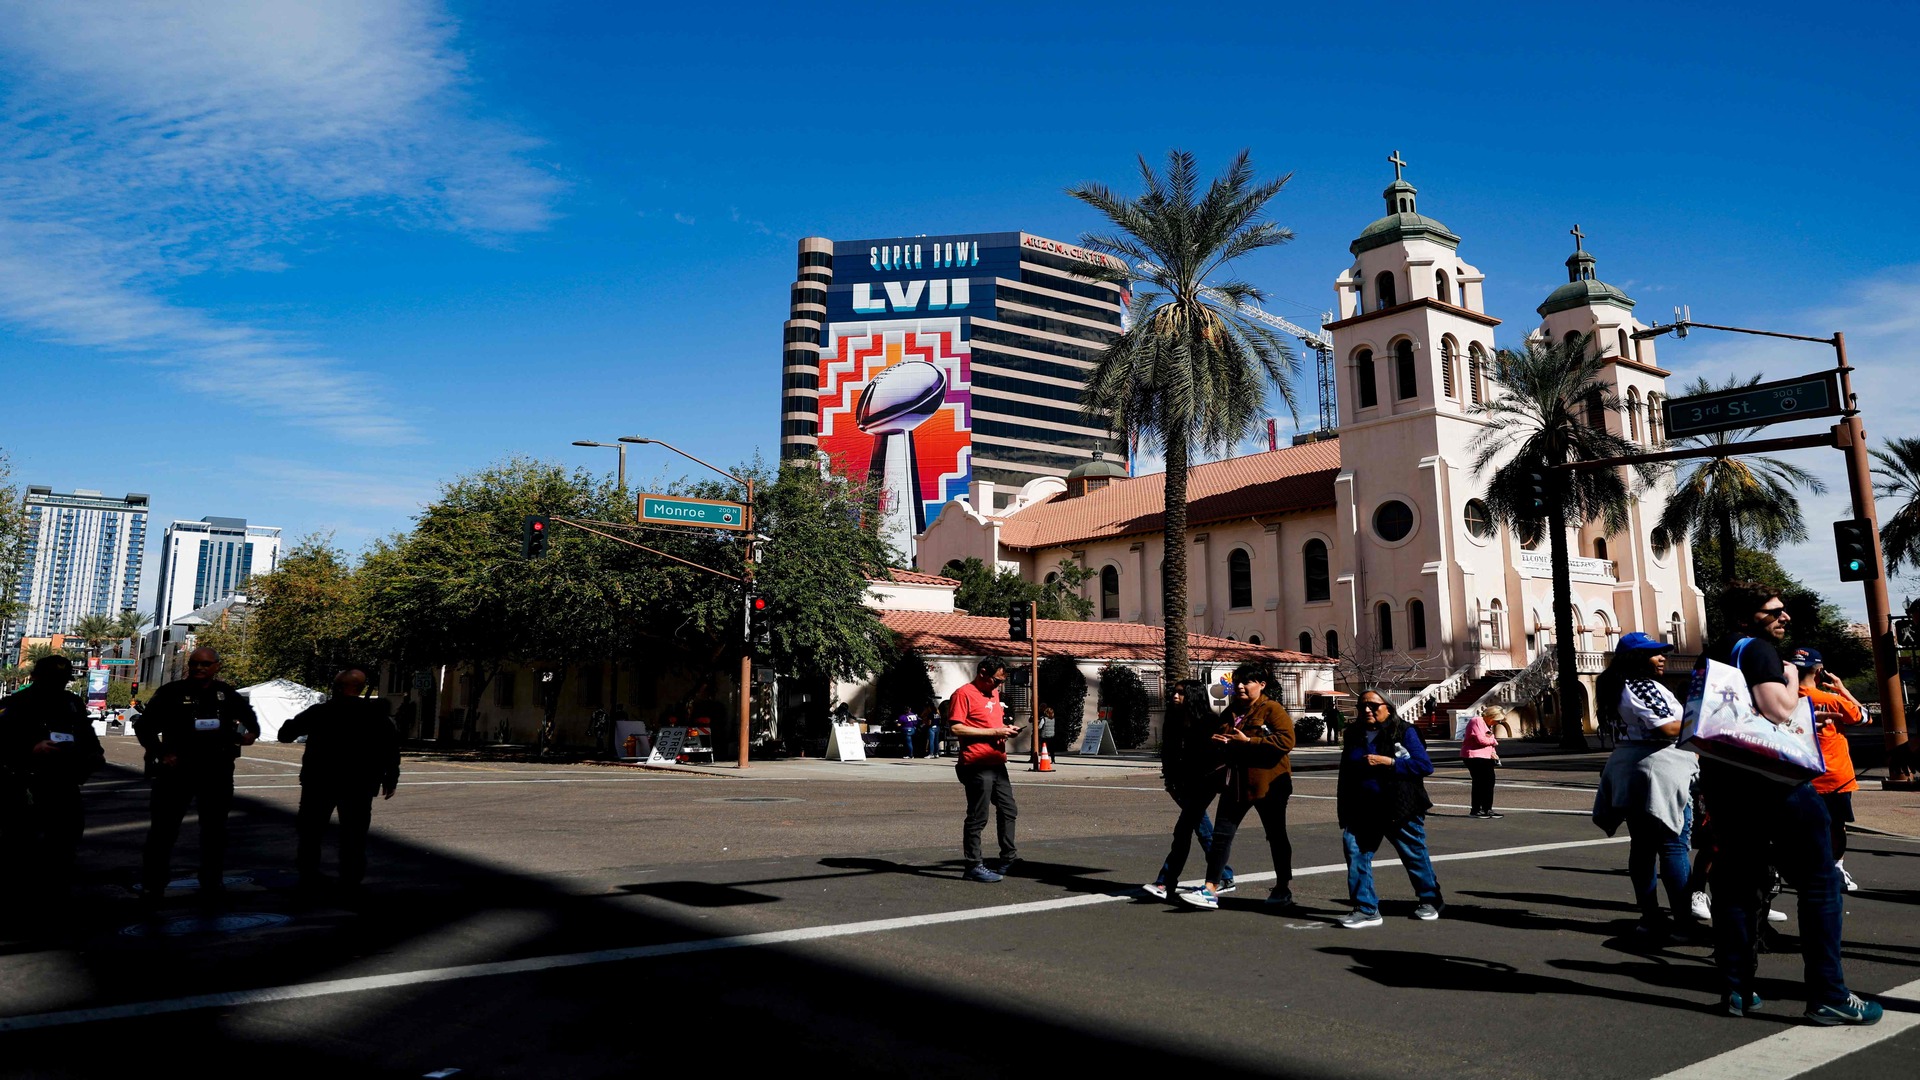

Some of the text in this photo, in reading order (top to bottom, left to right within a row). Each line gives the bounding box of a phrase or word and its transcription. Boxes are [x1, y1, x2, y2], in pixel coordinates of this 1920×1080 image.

[870, 241, 980, 269] SUPER BOWL
[1024, 236, 1108, 266] ARIZONA CENTER
[853, 278, 970, 312] LVII
[1773, 389, 1793, 399] 300
[1691, 400, 1757, 422] 3rd St.
[654, 503, 706, 518] Monroe
[653, 730, 671, 761] CLOSED
[665, 731, 683, 761] STREET
[1719, 728, 1802, 757] NFL PREFERS VISA
